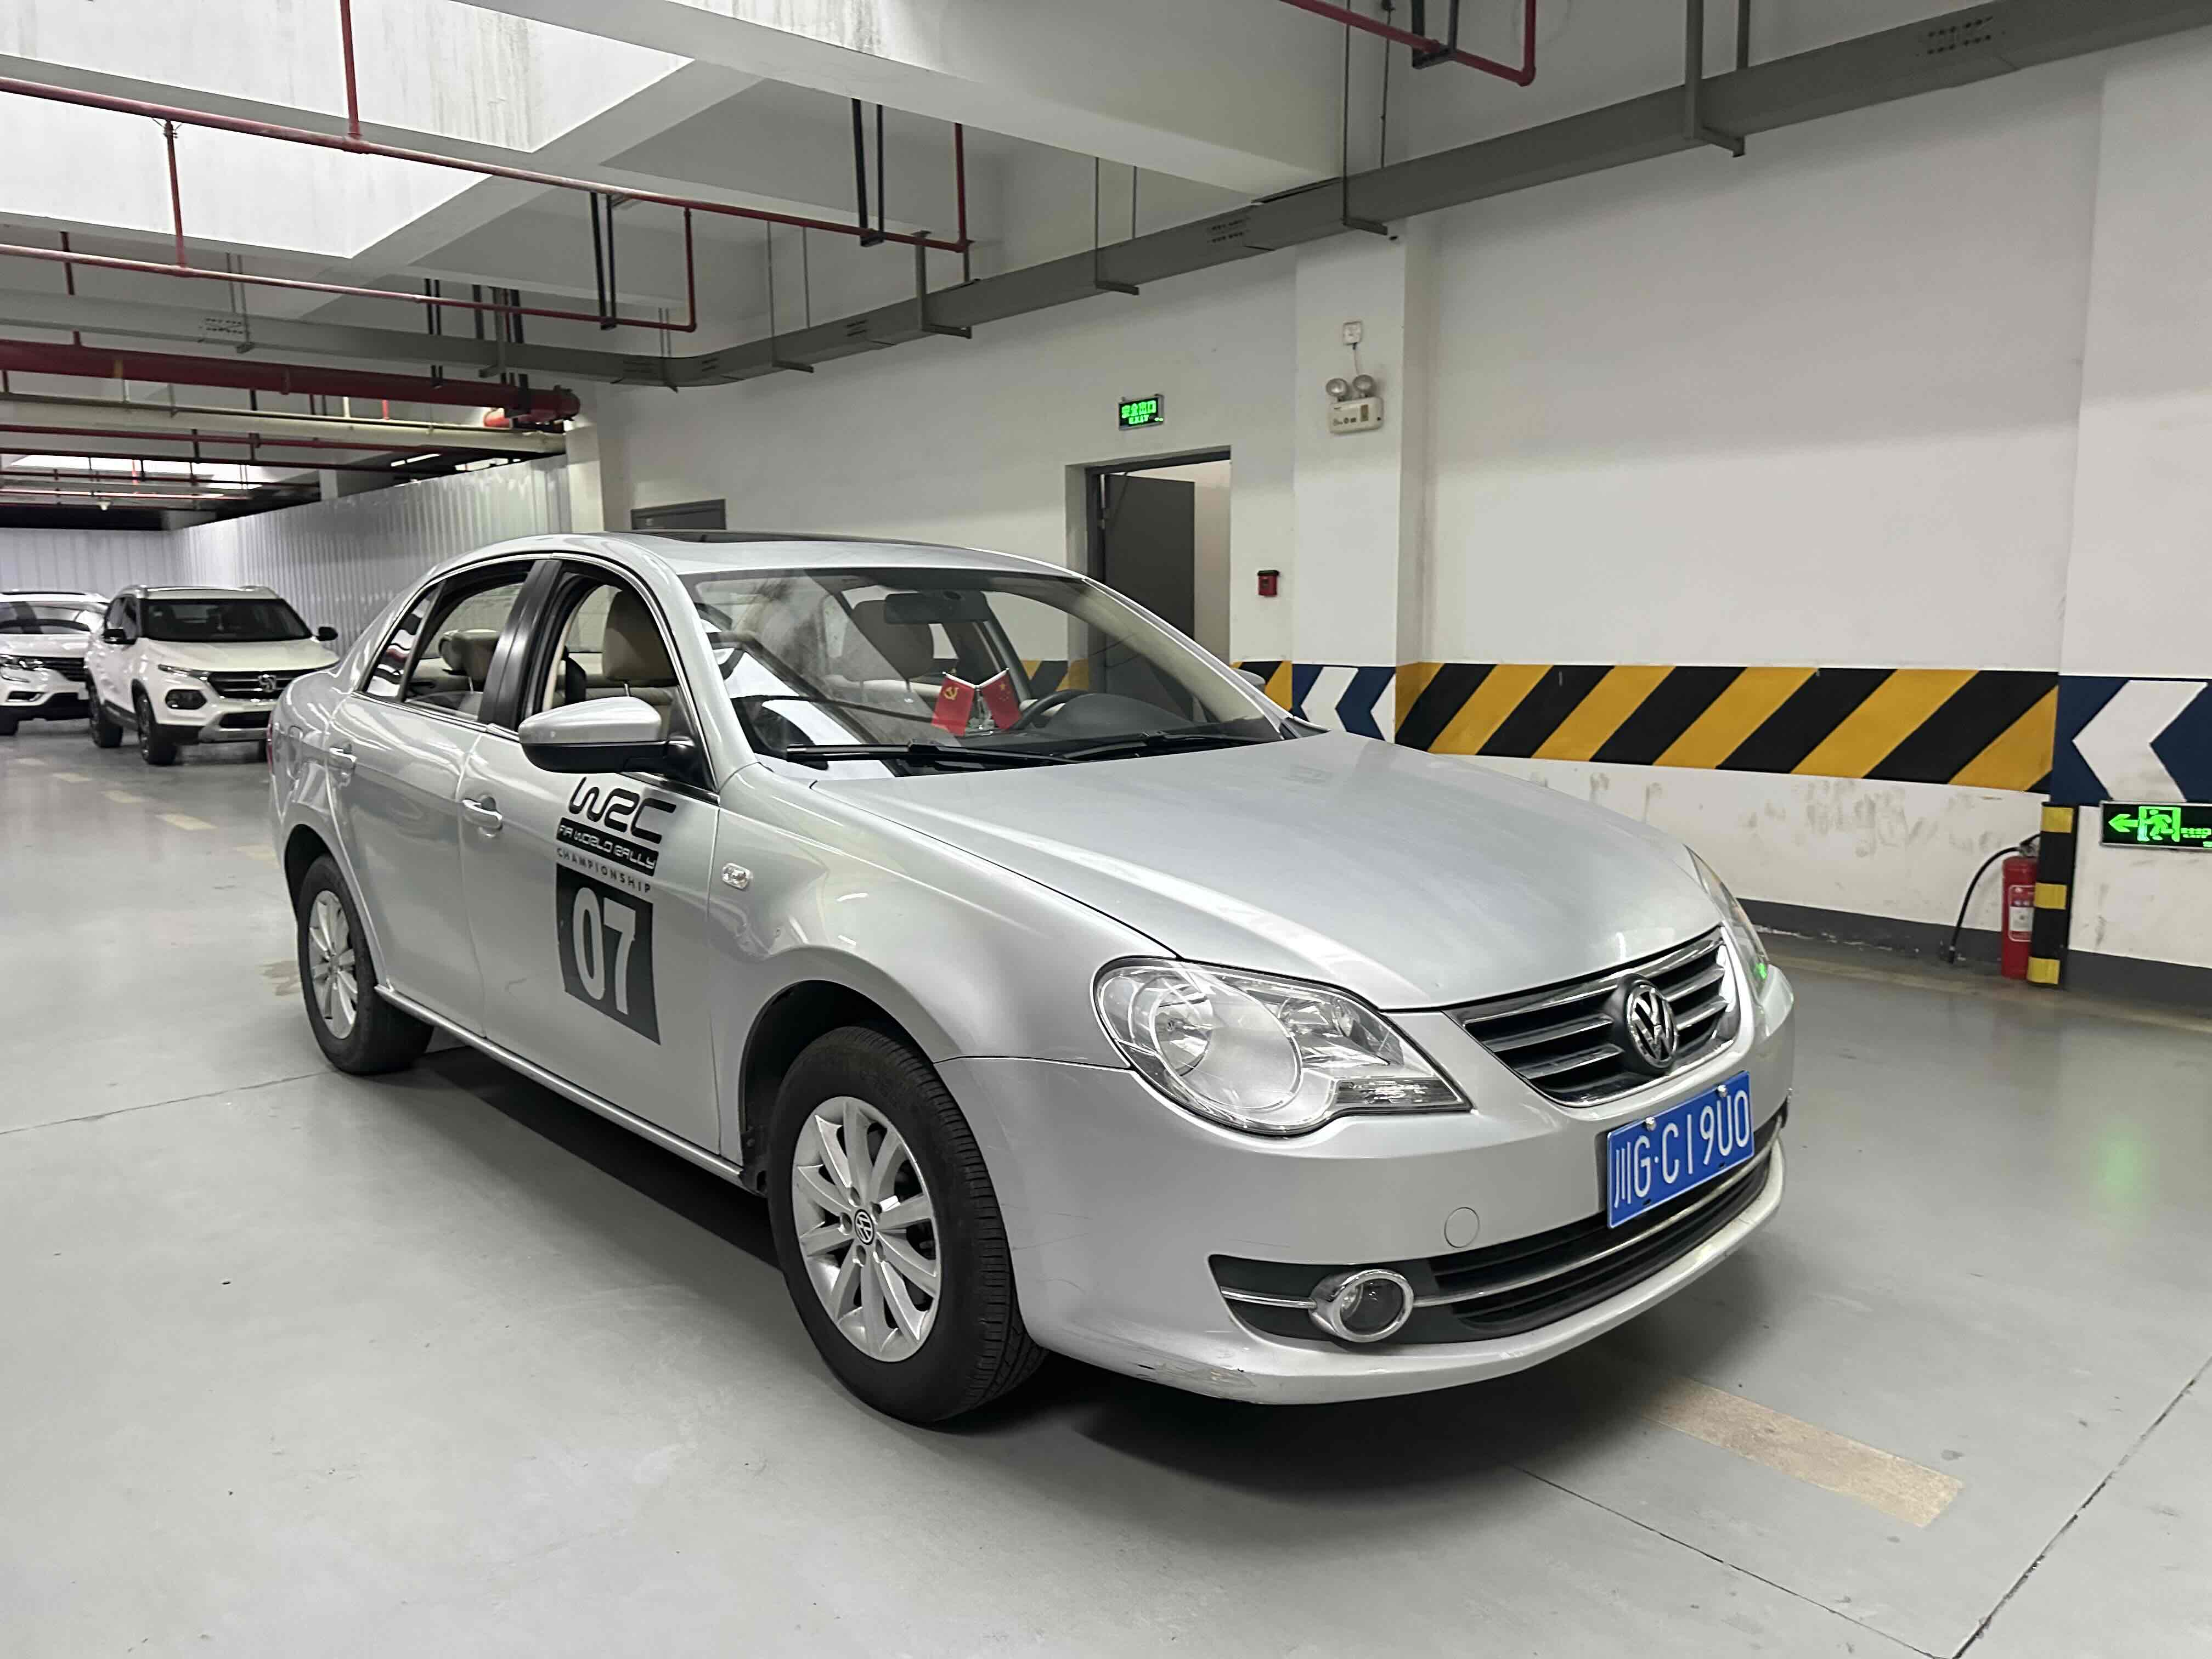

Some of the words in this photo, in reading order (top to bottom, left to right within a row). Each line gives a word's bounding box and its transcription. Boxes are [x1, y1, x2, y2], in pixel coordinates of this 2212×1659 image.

[569, 777, 676, 844] WRC
[557, 848, 651, 893] CHAMPIONSHIP
[573, 887, 635, 1015] 07
